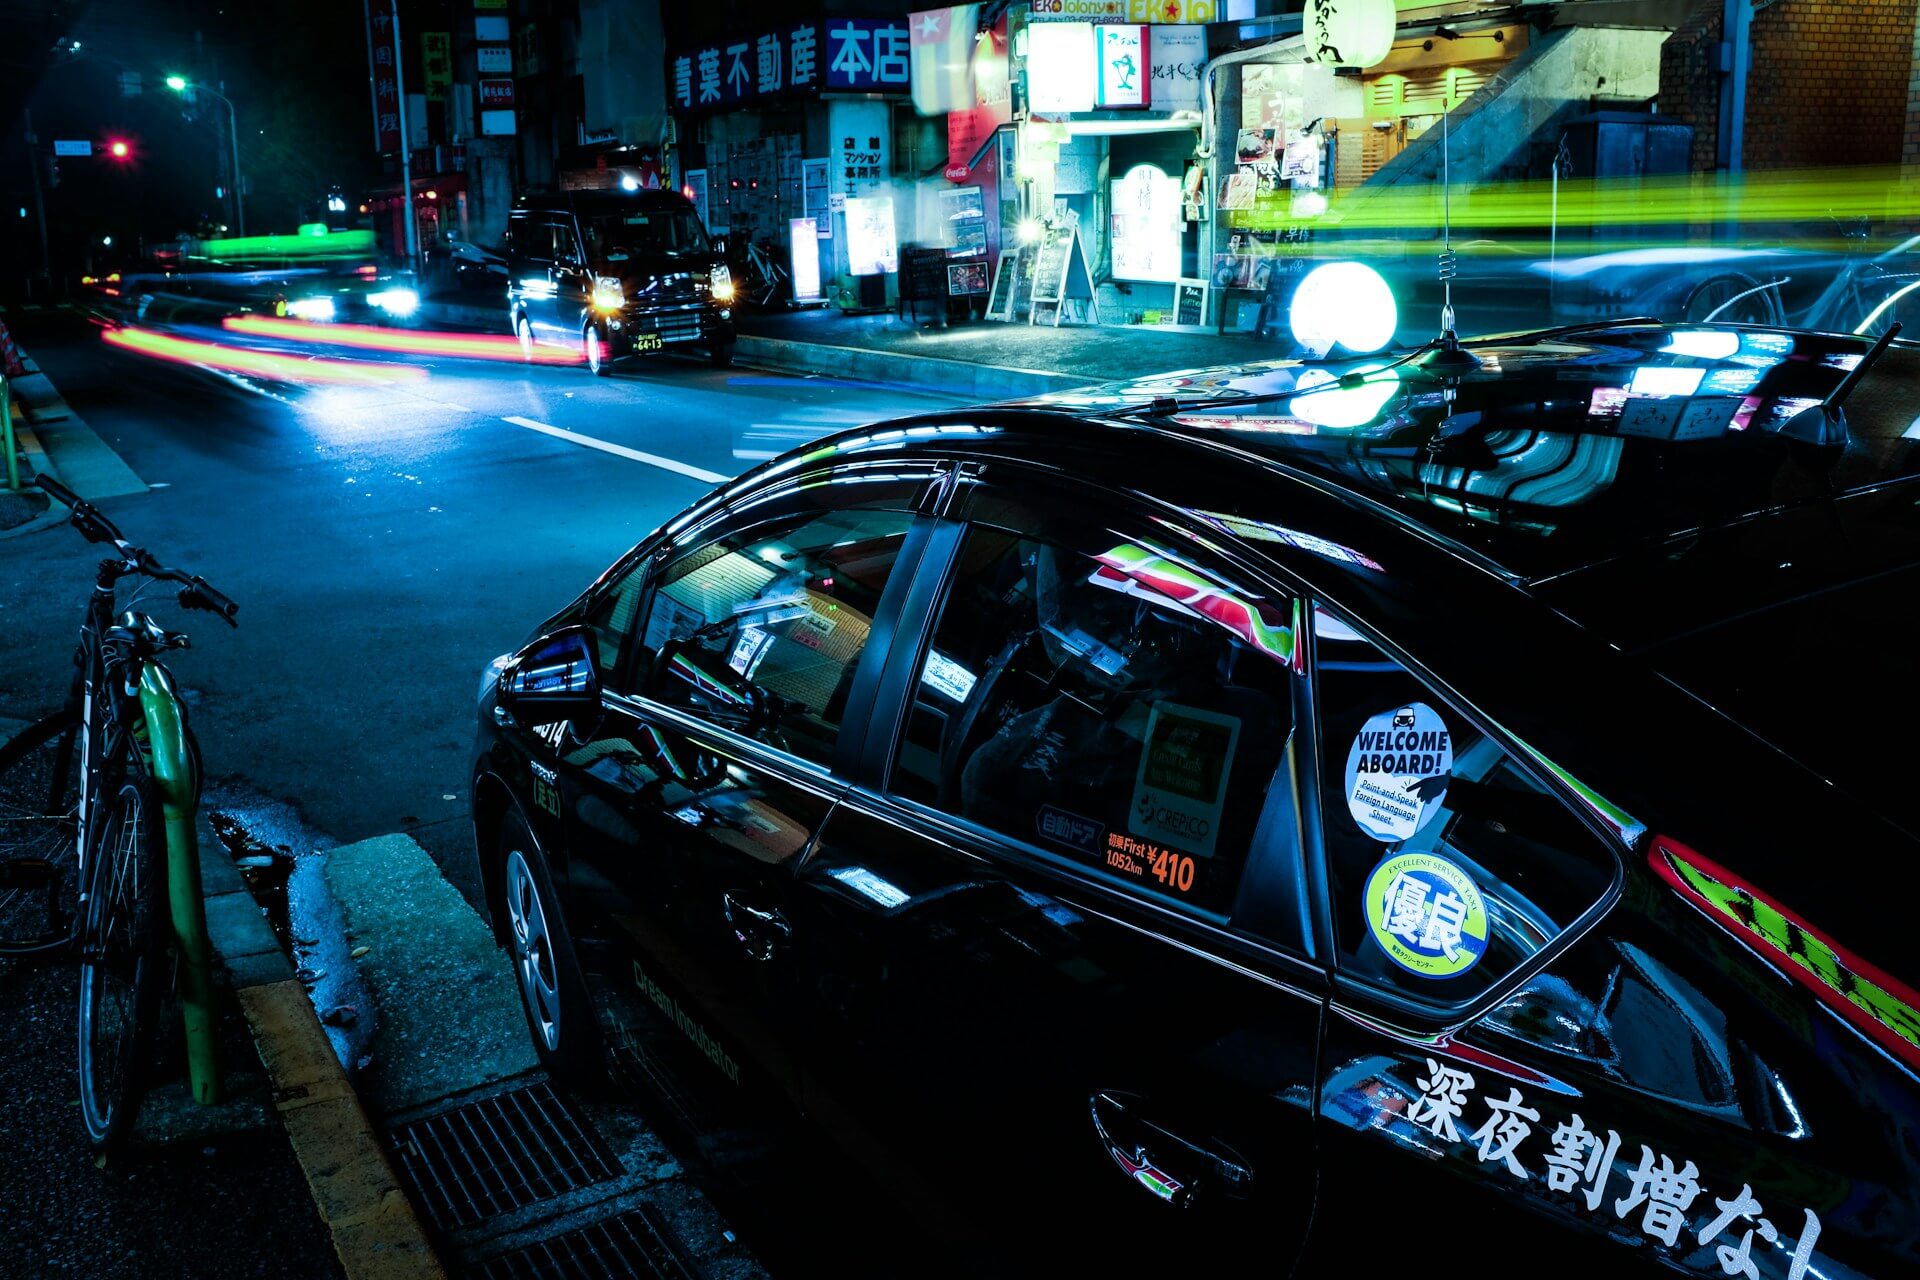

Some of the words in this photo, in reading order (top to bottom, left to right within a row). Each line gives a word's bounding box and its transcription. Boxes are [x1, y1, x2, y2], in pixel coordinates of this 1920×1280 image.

[675, 24, 817, 107] 青葉不動産
[829, 21, 910, 84] 本店
[843, 152, 881, 165] マンション
[844, 166, 881, 179] 事務所
[1358, 731, 1449, 751] WELCOME
[1356, 753, 1442, 775] ABOARD!
[1355, 790, 1381, 807] Foreign
[1382, 800, 1416, 822] Language
[1361, 780, 1418, 808] Point-and-Speak
[1043, 812, 1096, 845] 自動ドア
[1371, 810, 1393, 825] Sheet
[1106, 850, 1143, 876] 1.052km
[1388, 858, 1431, 874] EXCELLENT
[1433, 861, 1464, 886] SERVICE
[1464, 887, 1477, 911] TAXI
[1381, 869, 1468, 964] 優良
[632, 958, 675, 1018] Dream
[675, 998, 742, 1089] Incubator
